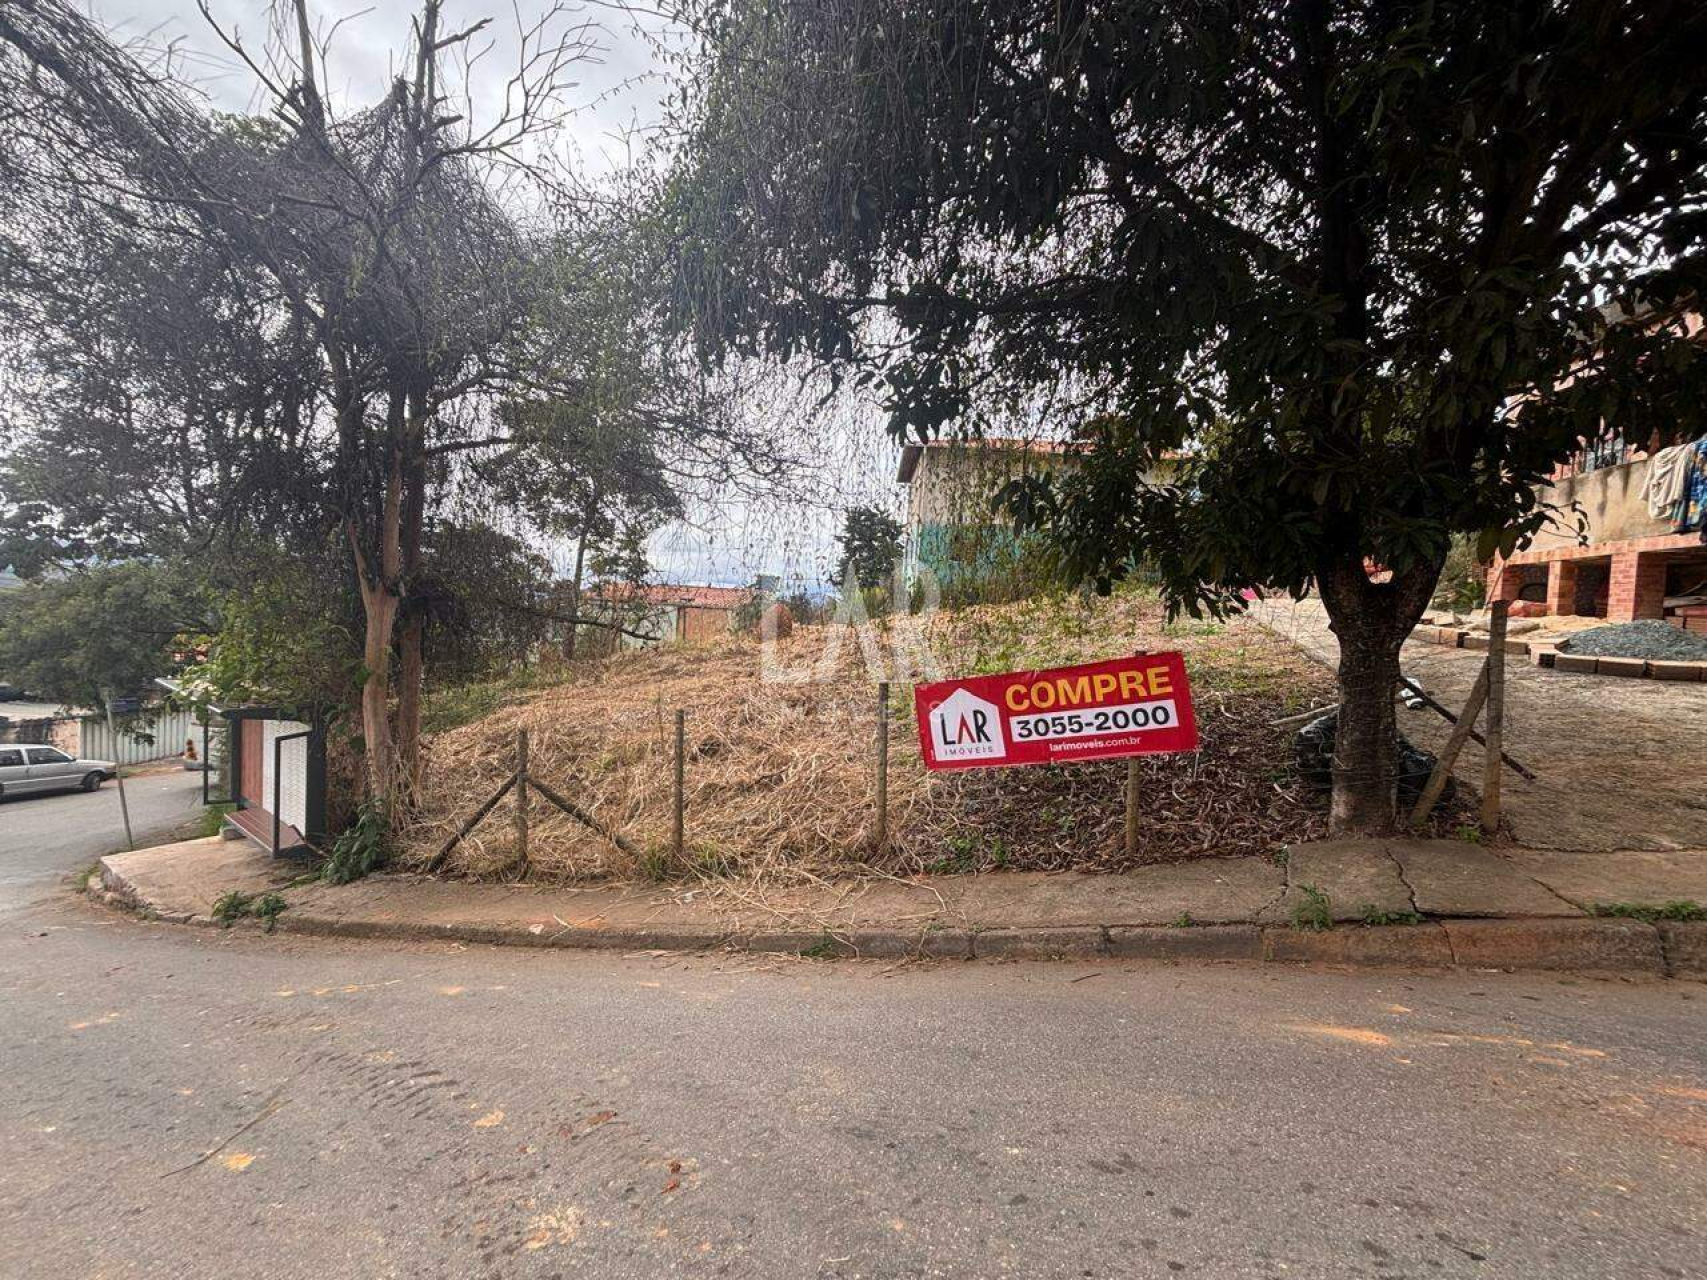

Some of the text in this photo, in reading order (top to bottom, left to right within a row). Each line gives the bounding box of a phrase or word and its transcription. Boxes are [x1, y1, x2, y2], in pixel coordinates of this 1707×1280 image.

[1005, 666, 1174, 711] COMPRE
[940, 709, 992, 745] LAR
[1016, 705, 1170, 739] 3055-2000
[1049, 736, 1142, 751] larimoveis.com.br
